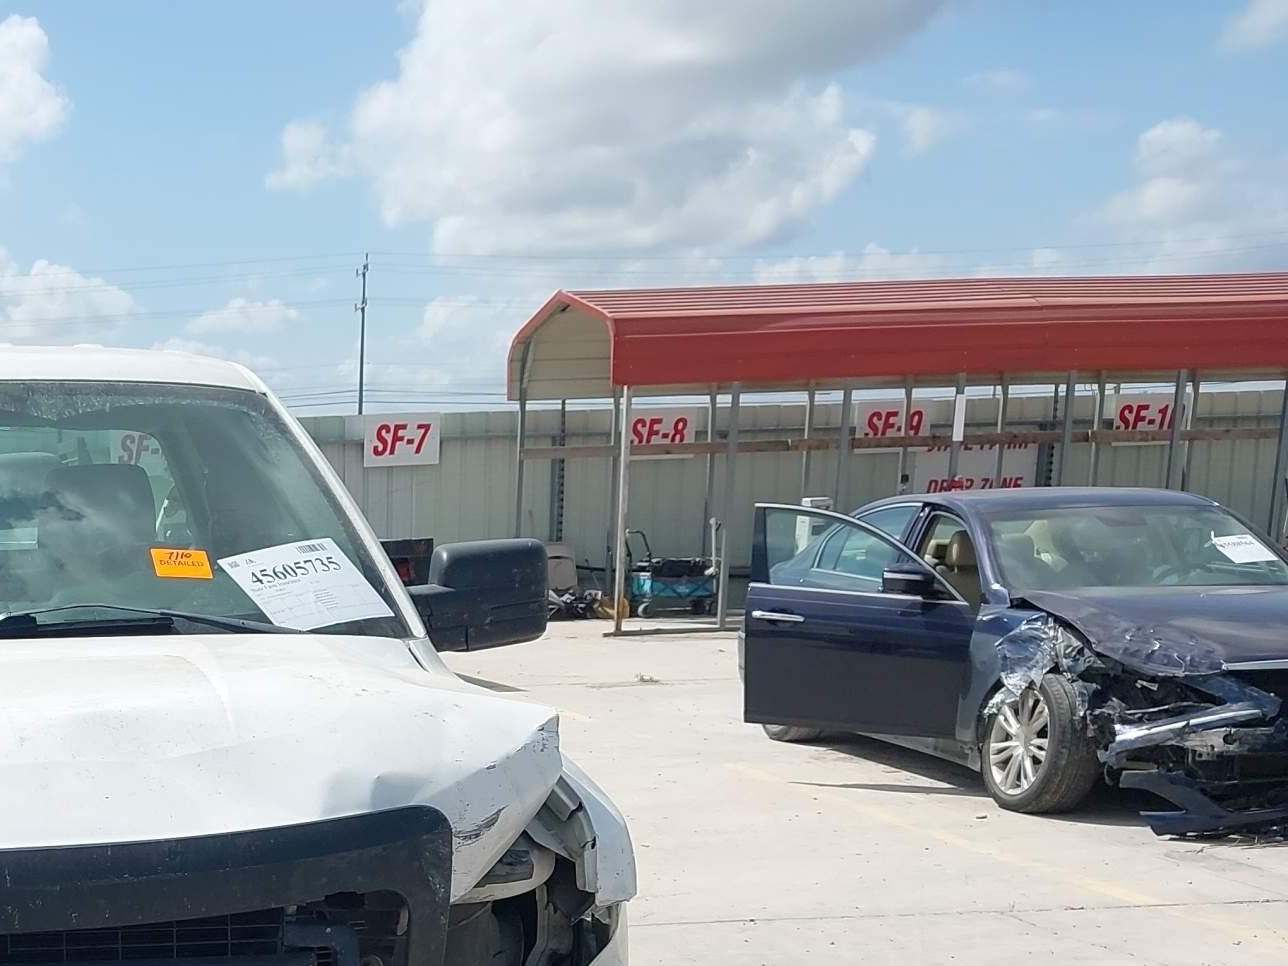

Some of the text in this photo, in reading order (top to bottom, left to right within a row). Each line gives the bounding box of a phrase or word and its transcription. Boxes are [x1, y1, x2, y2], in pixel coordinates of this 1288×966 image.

[631, 417, 688, 444] SF-8
[864, 410, 923, 436] SF-9
[372, 423, 430, 456] SF-7
[981, 477, 1024, 489] ZNE
[250, 556, 343, 585] 45605735
